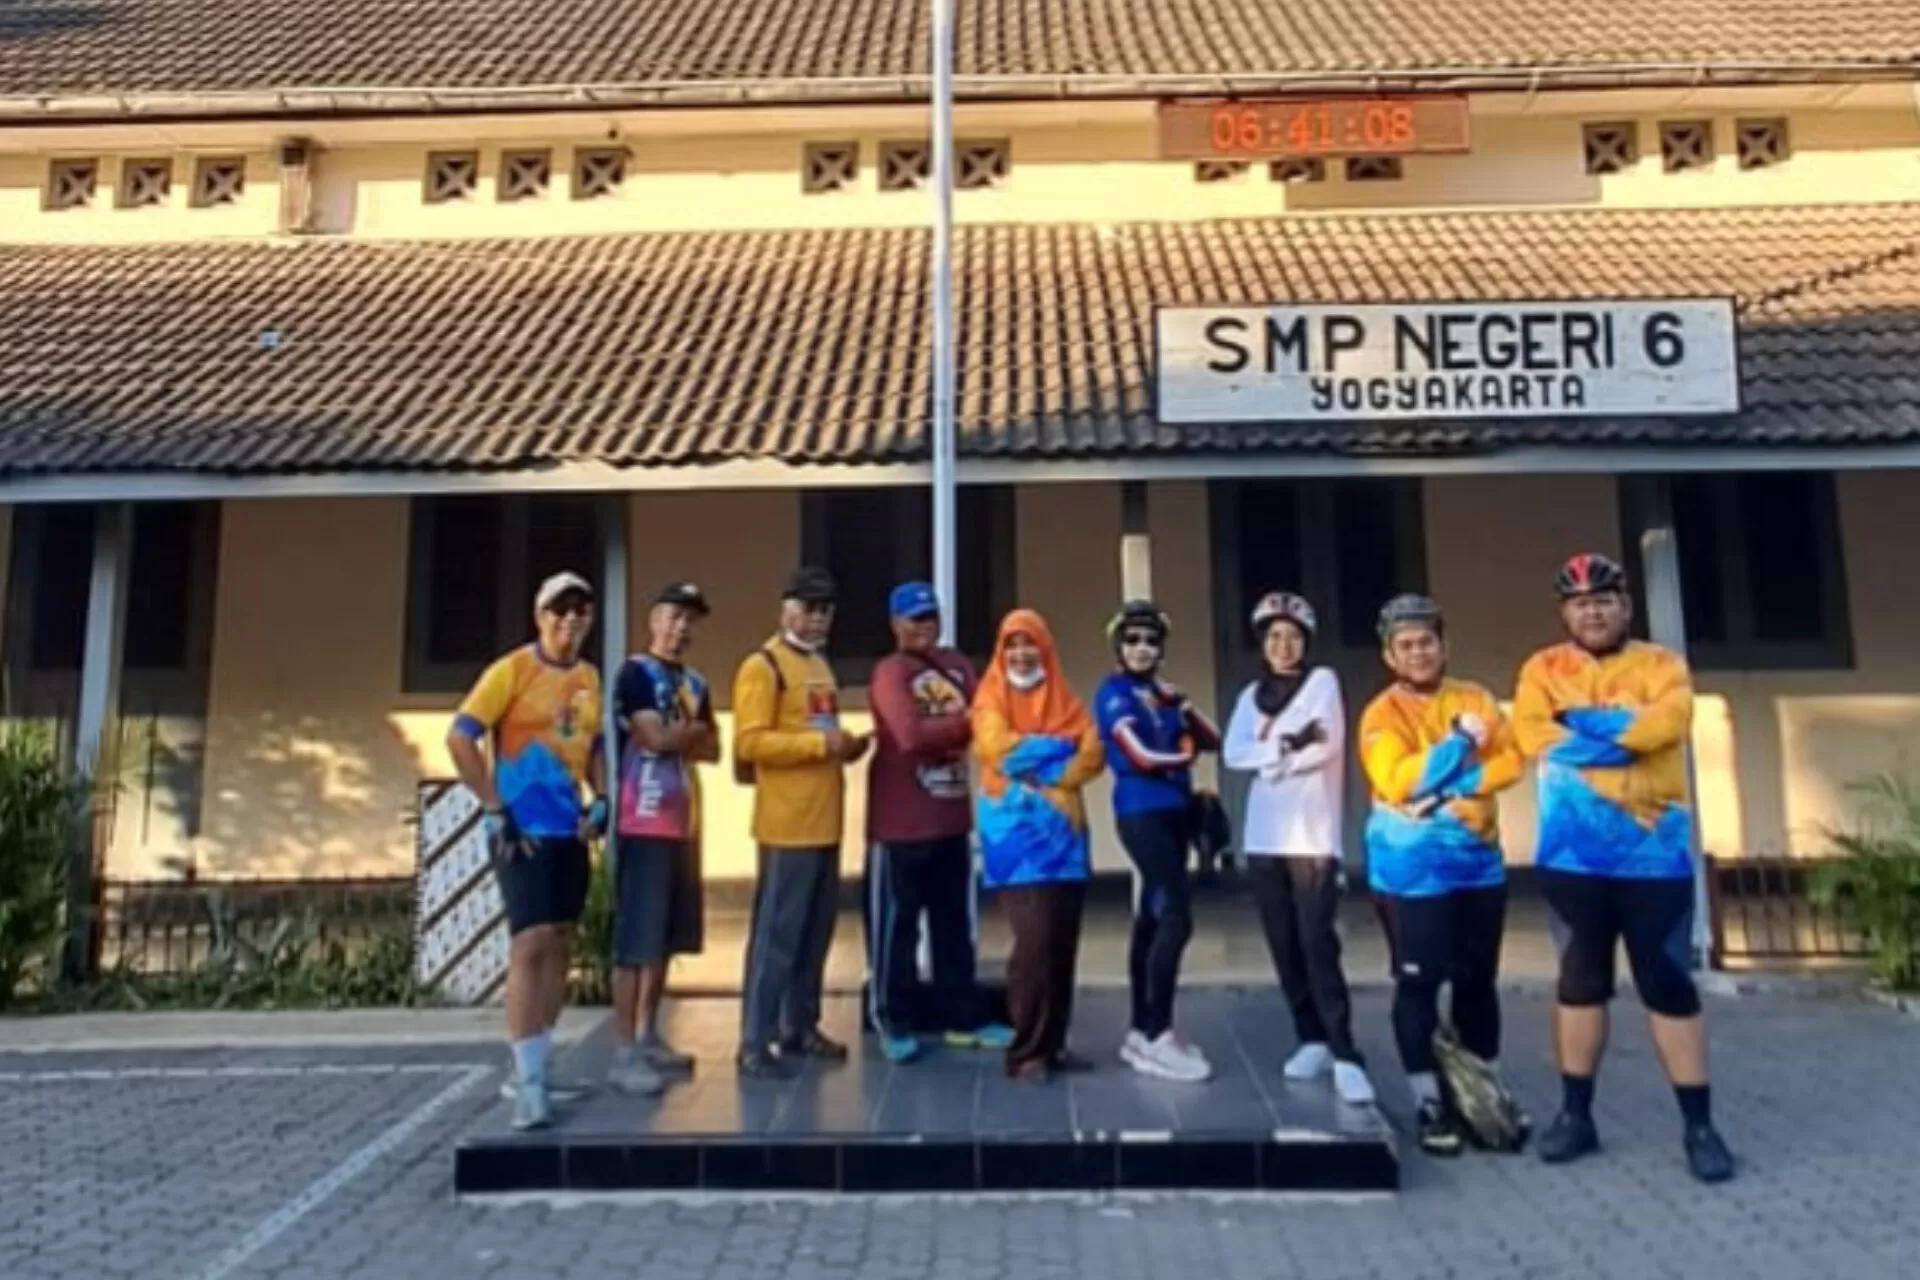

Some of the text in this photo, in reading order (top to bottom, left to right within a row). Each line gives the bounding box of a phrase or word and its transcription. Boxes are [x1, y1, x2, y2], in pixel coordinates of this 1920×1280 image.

[1213, 103, 1413, 149] 06:41:08
[1205, 311, 1685, 373] SMP NEGERI 6
[1311, 374, 1585, 411] YOGYAKARTA
